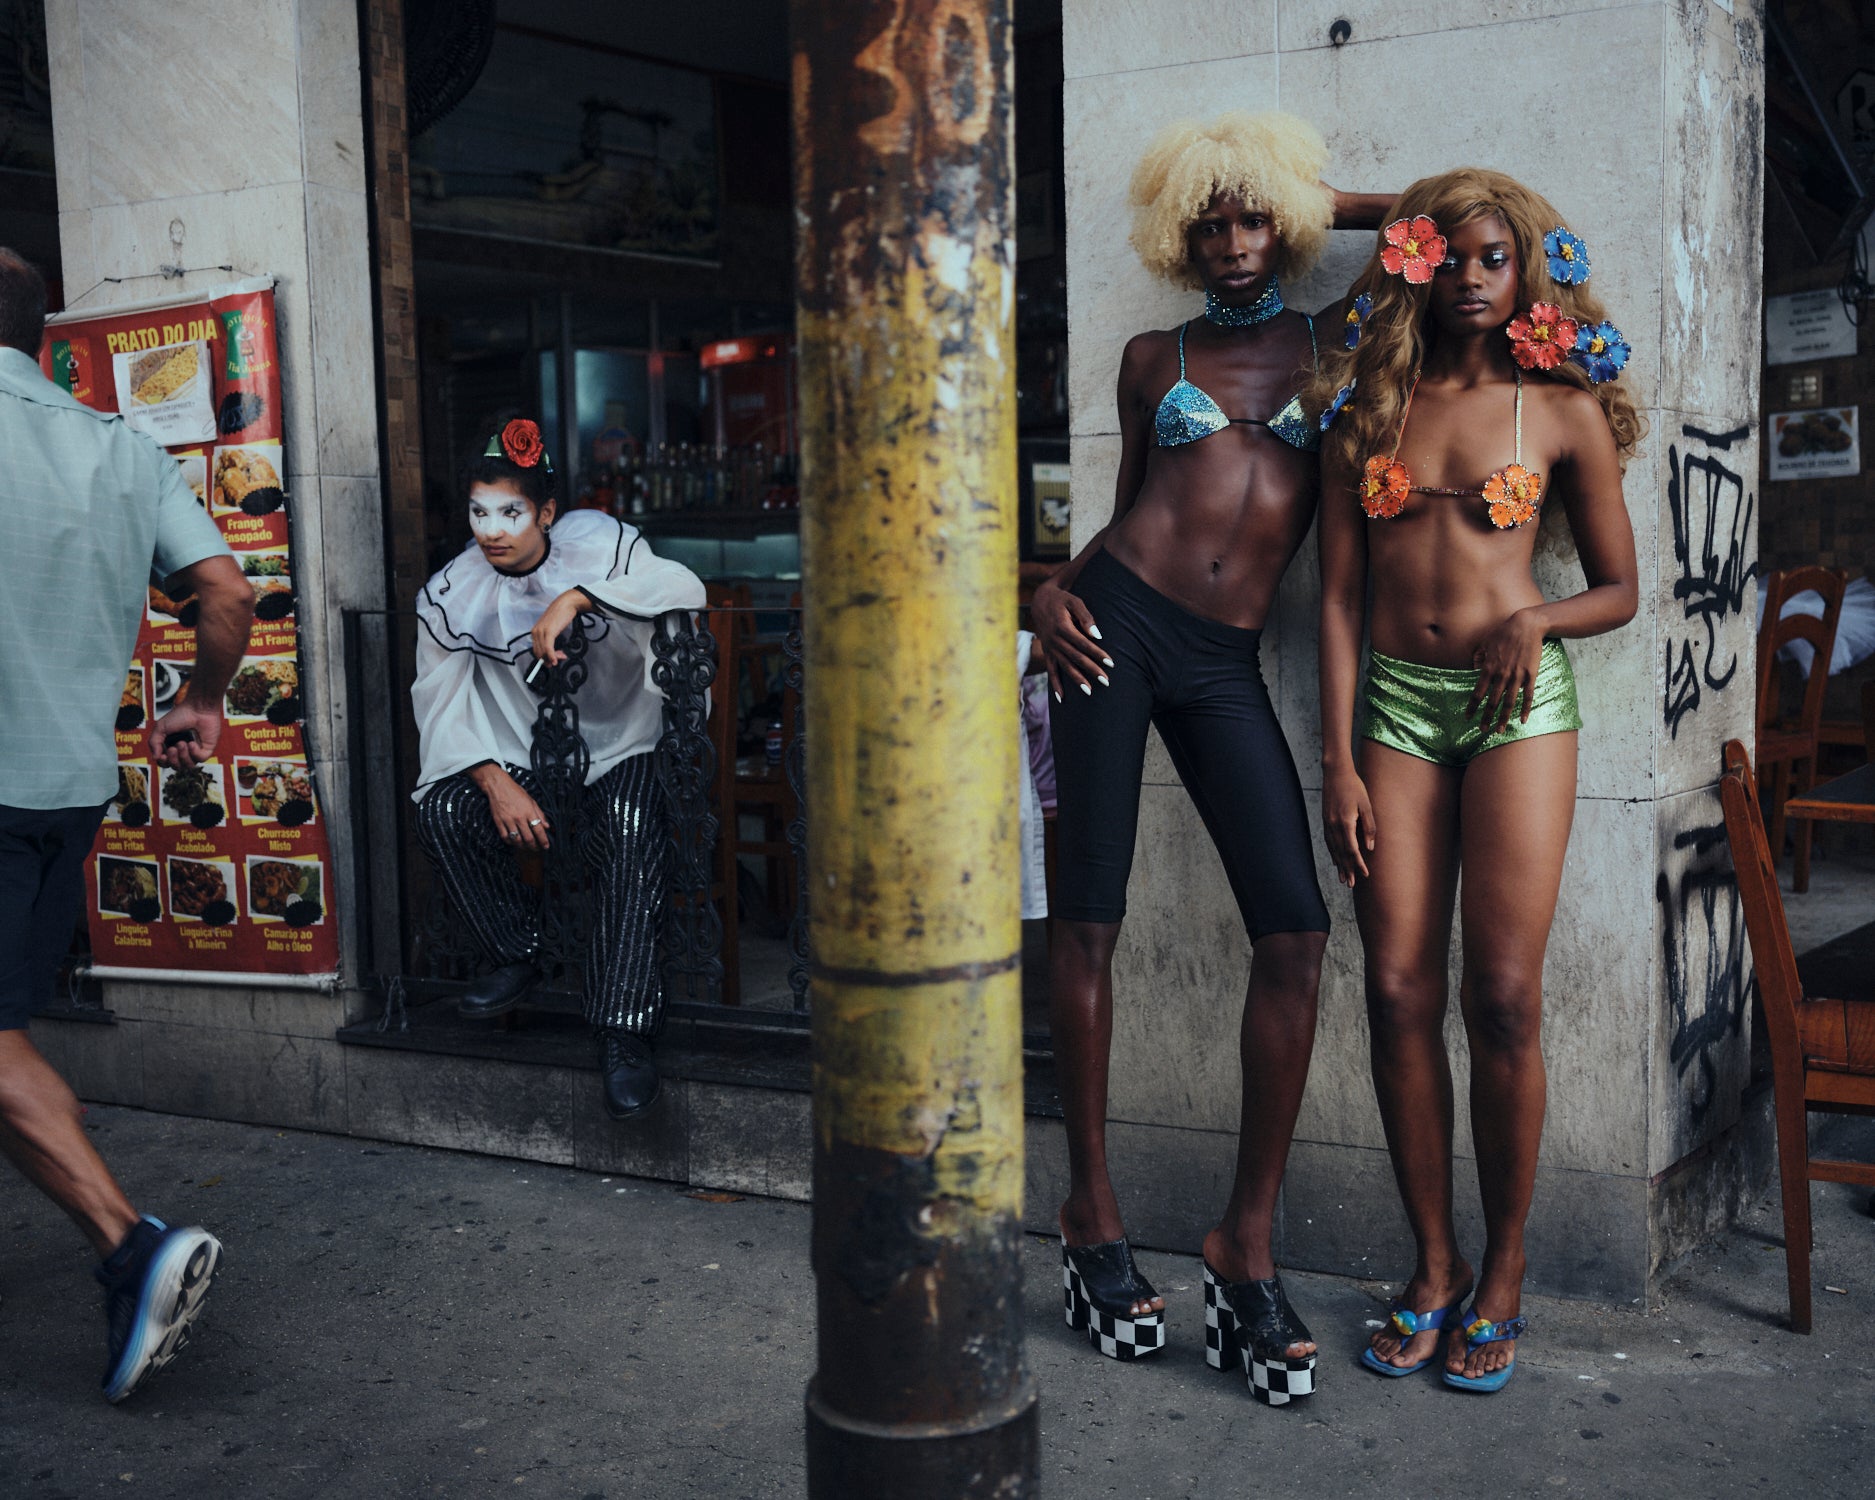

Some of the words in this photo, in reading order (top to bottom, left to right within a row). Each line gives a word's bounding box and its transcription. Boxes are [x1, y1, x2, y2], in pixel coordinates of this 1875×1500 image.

[107, 328, 160, 354] PRATO
[163, 323, 186, 345] DO
[189, 319, 218, 341] DIA
[227, 518, 264, 530] Frango
[223, 529, 273, 544] Ensopado
[251, 622, 281, 636] giana
[152, 643, 172, 653] Carne
[174, 643, 183, 652] ou
[184, 641, 197, 652] Fra
[250, 637, 263, 647] ou
[116, 732, 142, 745] Frango
[244, 728, 275, 739] Contra
[278, 726, 295, 738] Filé
[250, 739, 292, 751] Grelhado
[118, 828, 145, 840] Mignon
[257, 828, 301, 839] Churrasco
[107, 842, 122, 851] com
[124, 840, 145, 851] Fritas
[176, 841, 216, 853] Acebolado
[269, 840, 291, 851] Misto
[116, 923, 149, 937] Linguiça
[180, 926, 212, 940] Linguiça
[214, 927, 233, 938] Fina
[264, 927, 298, 940] Camarão
[300, 930, 313, 939] ao
[114, 935, 152, 947] Calabresa
[195, 939, 227, 950] Mineira
[267, 940, 284, 951] Alho
[285, 943, 290, 951] e
[292, 939, 313, 952] Óleo
